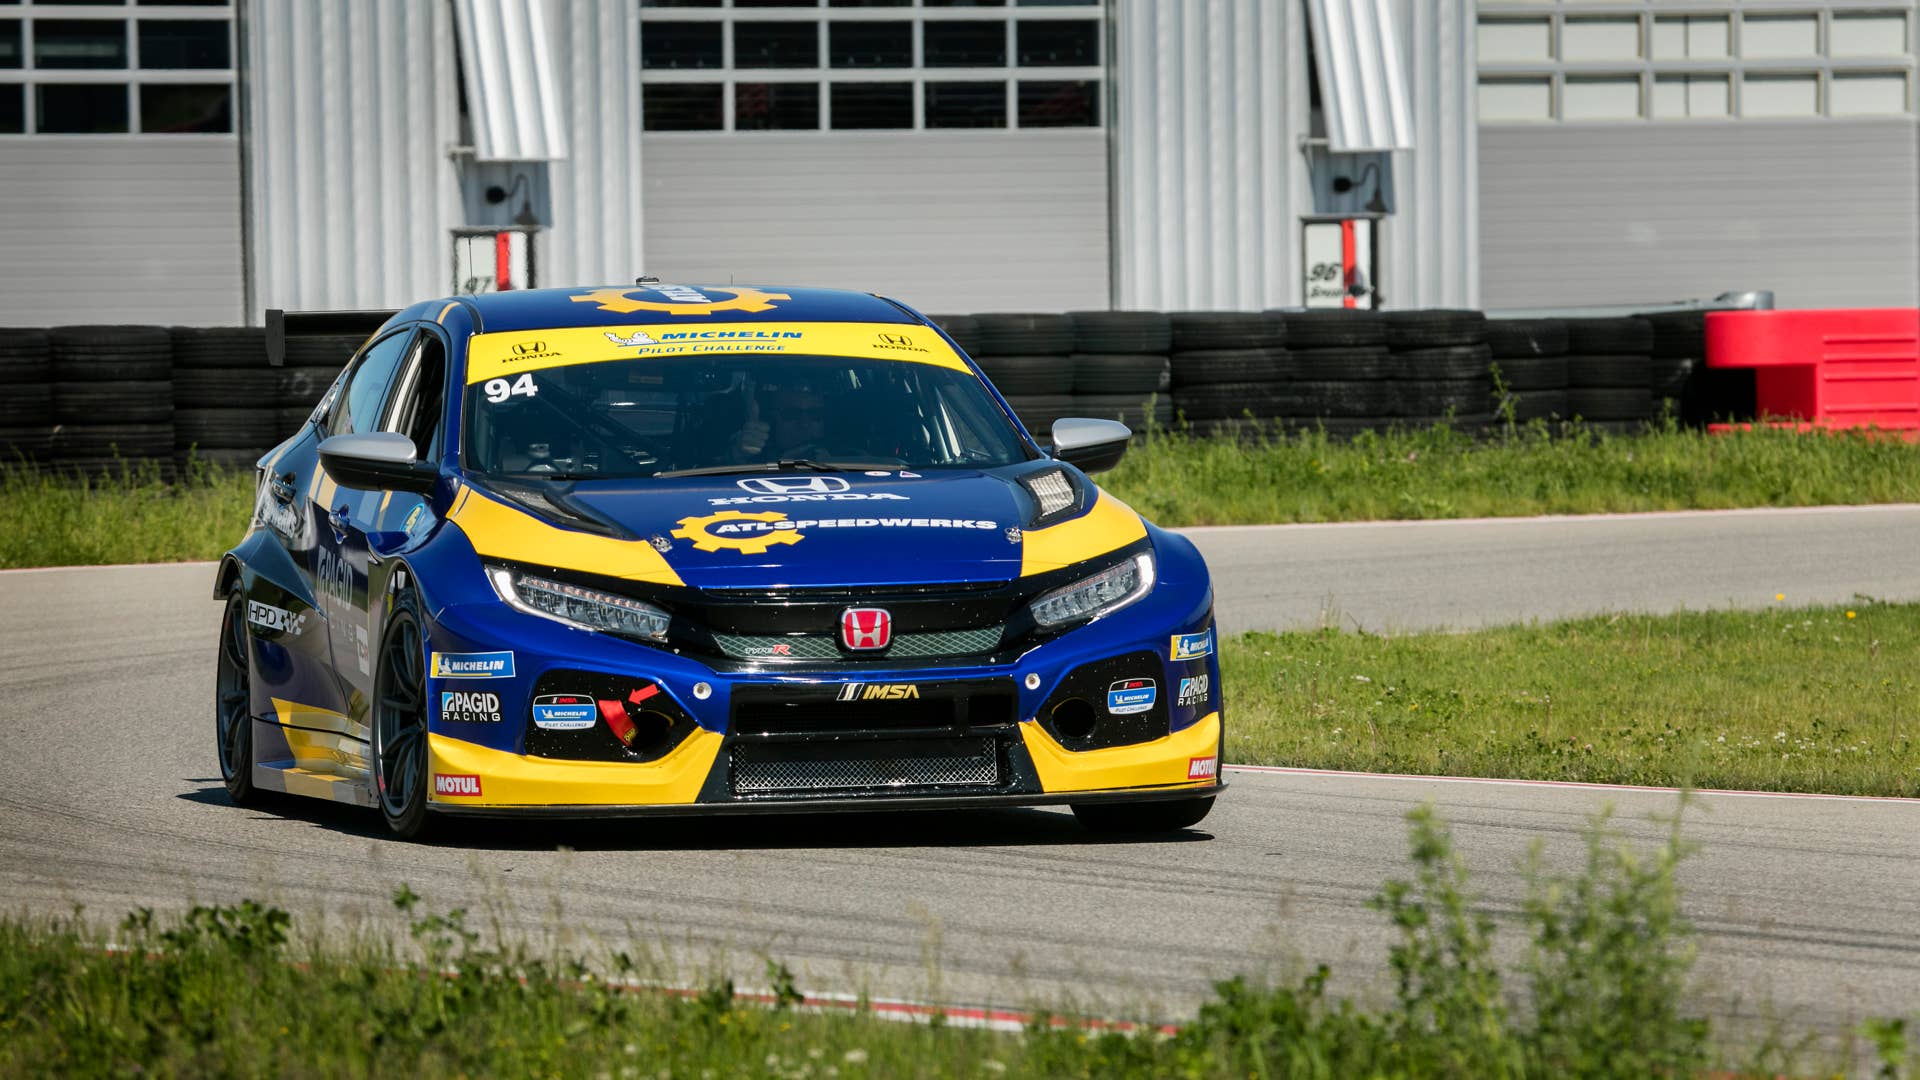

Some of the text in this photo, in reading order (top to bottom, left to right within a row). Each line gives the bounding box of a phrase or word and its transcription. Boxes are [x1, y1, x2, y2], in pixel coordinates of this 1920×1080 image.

[661, 331, 802, 341] MICHELIN
[638, 344, 786, 355] PILOT CHALLENGE
[872, 344, 929, 353] HONDA
[501, 352, 562, 364] HONDA
[484, 373, 539, 404] 94
[708, 493, 910, 505] HONDA
[249, 603, 277, 625] HPD
[452, 660, 505, 671] MICHELIN
[862, 685, 920, 699] IMSA
[455, 692, 499, 713] PAGID
[1177, 692, 1208, 707] RACING
[442, 712, 501, 722] RACING
[436, 776, 479, 792] MOTUL
